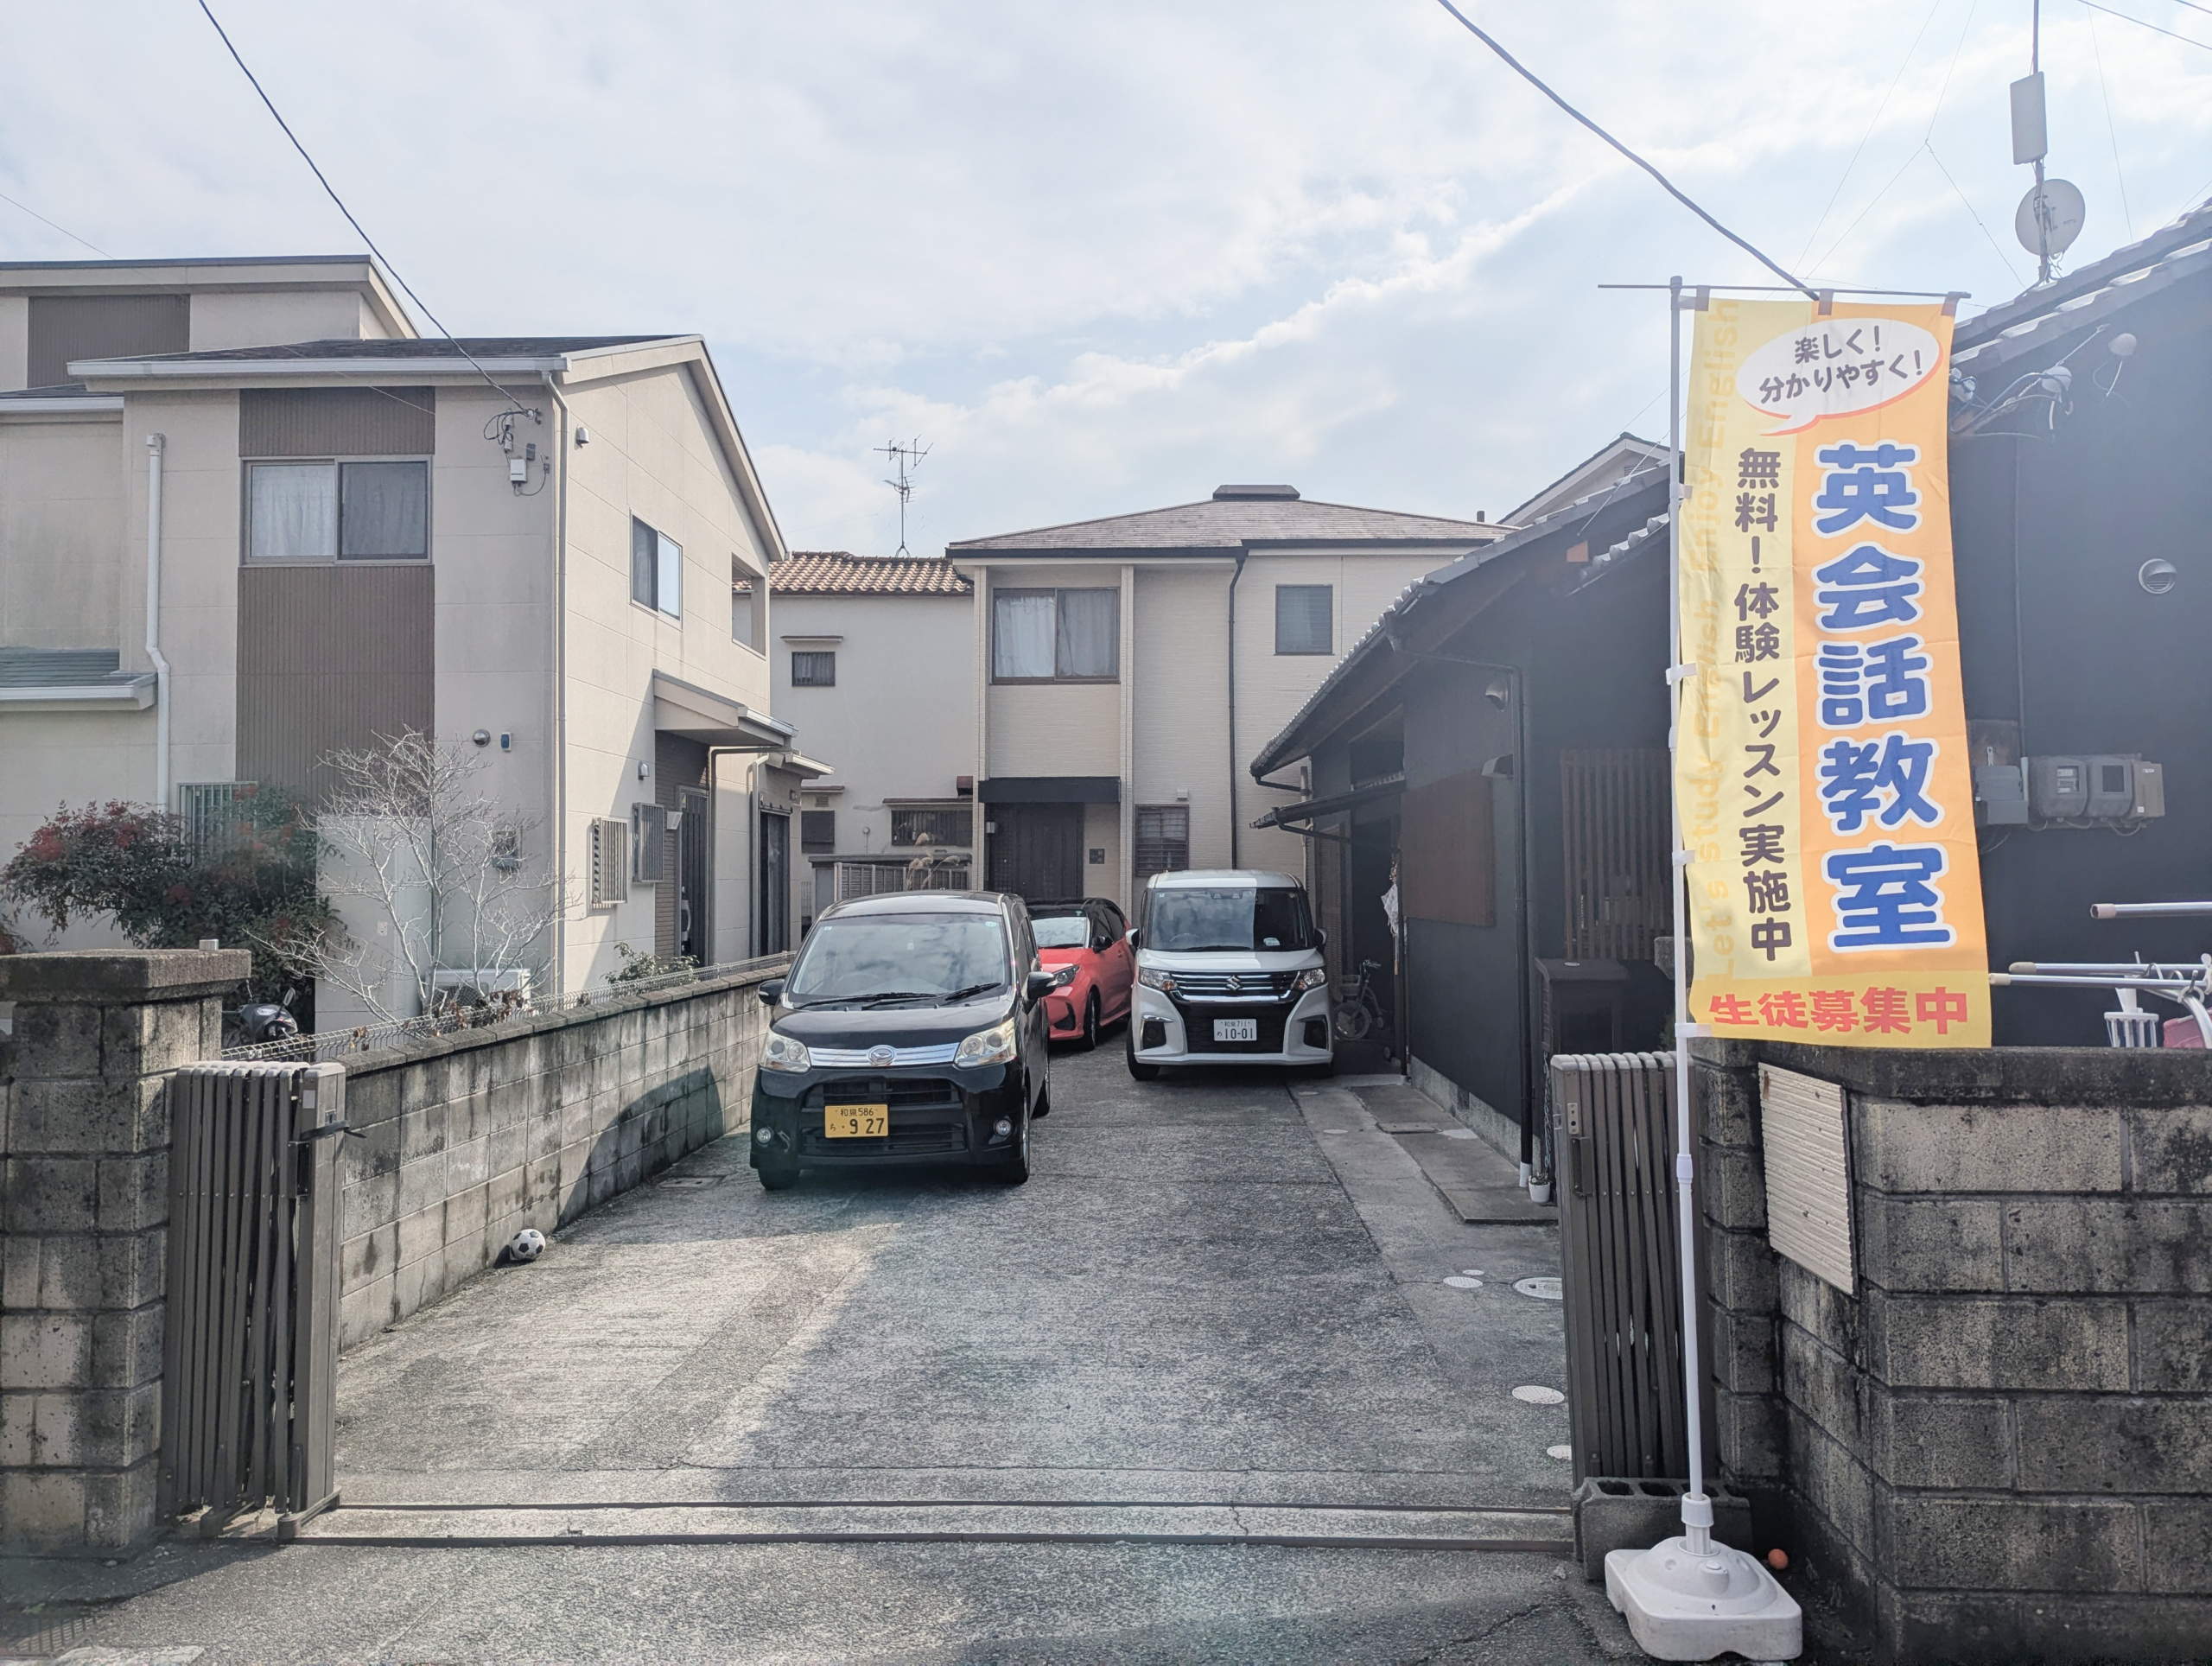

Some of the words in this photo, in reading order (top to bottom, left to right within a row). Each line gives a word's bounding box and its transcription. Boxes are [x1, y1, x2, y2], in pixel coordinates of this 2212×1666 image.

[1815, 442, 1953, 950] 英会話教室
[1708, 986, 1968, 1035] 生徒募集中
